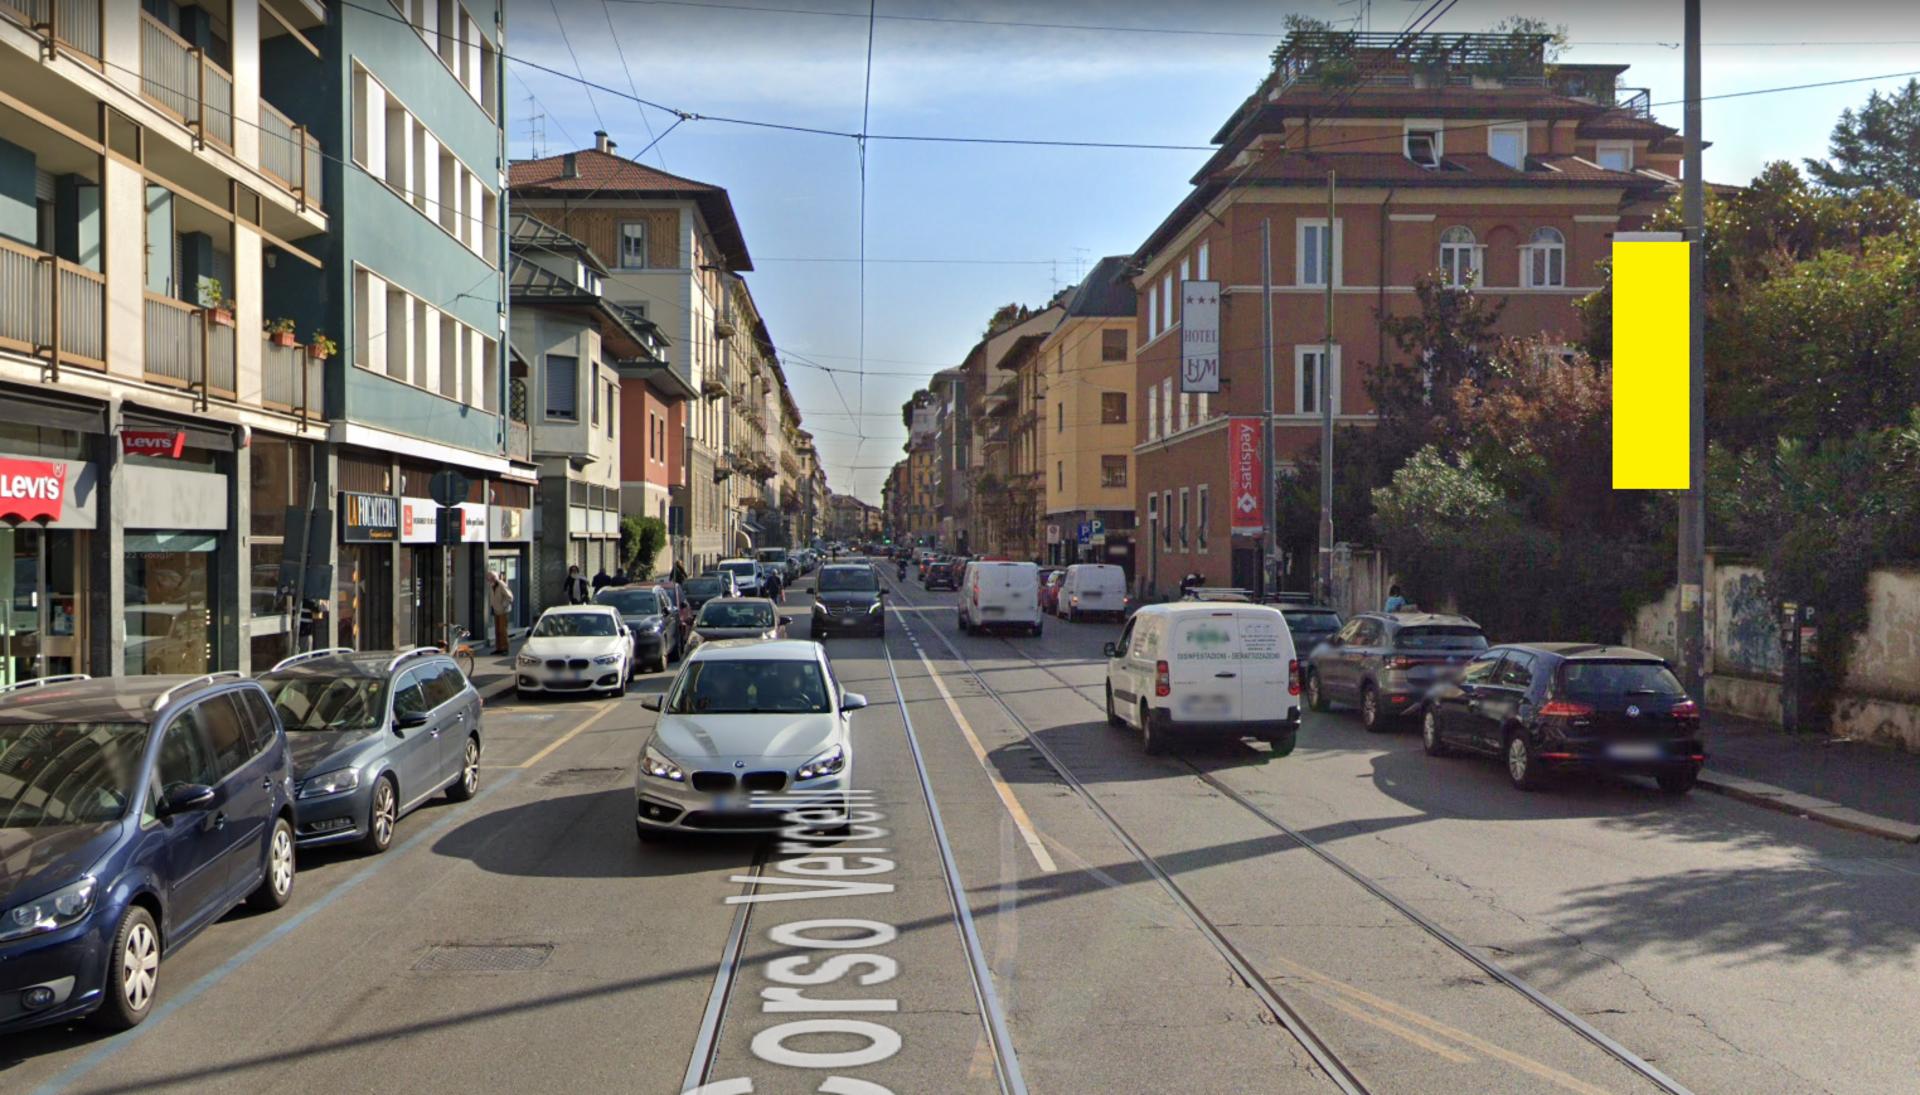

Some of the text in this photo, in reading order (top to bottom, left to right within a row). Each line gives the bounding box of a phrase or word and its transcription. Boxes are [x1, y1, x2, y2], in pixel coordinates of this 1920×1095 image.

[1184, 329, 1218, 344] HOTEL
[1240, 423, 1255, 490] satispay
[1091, 520, 1101, 533] P
[1805, 606, 1815, 620] P
